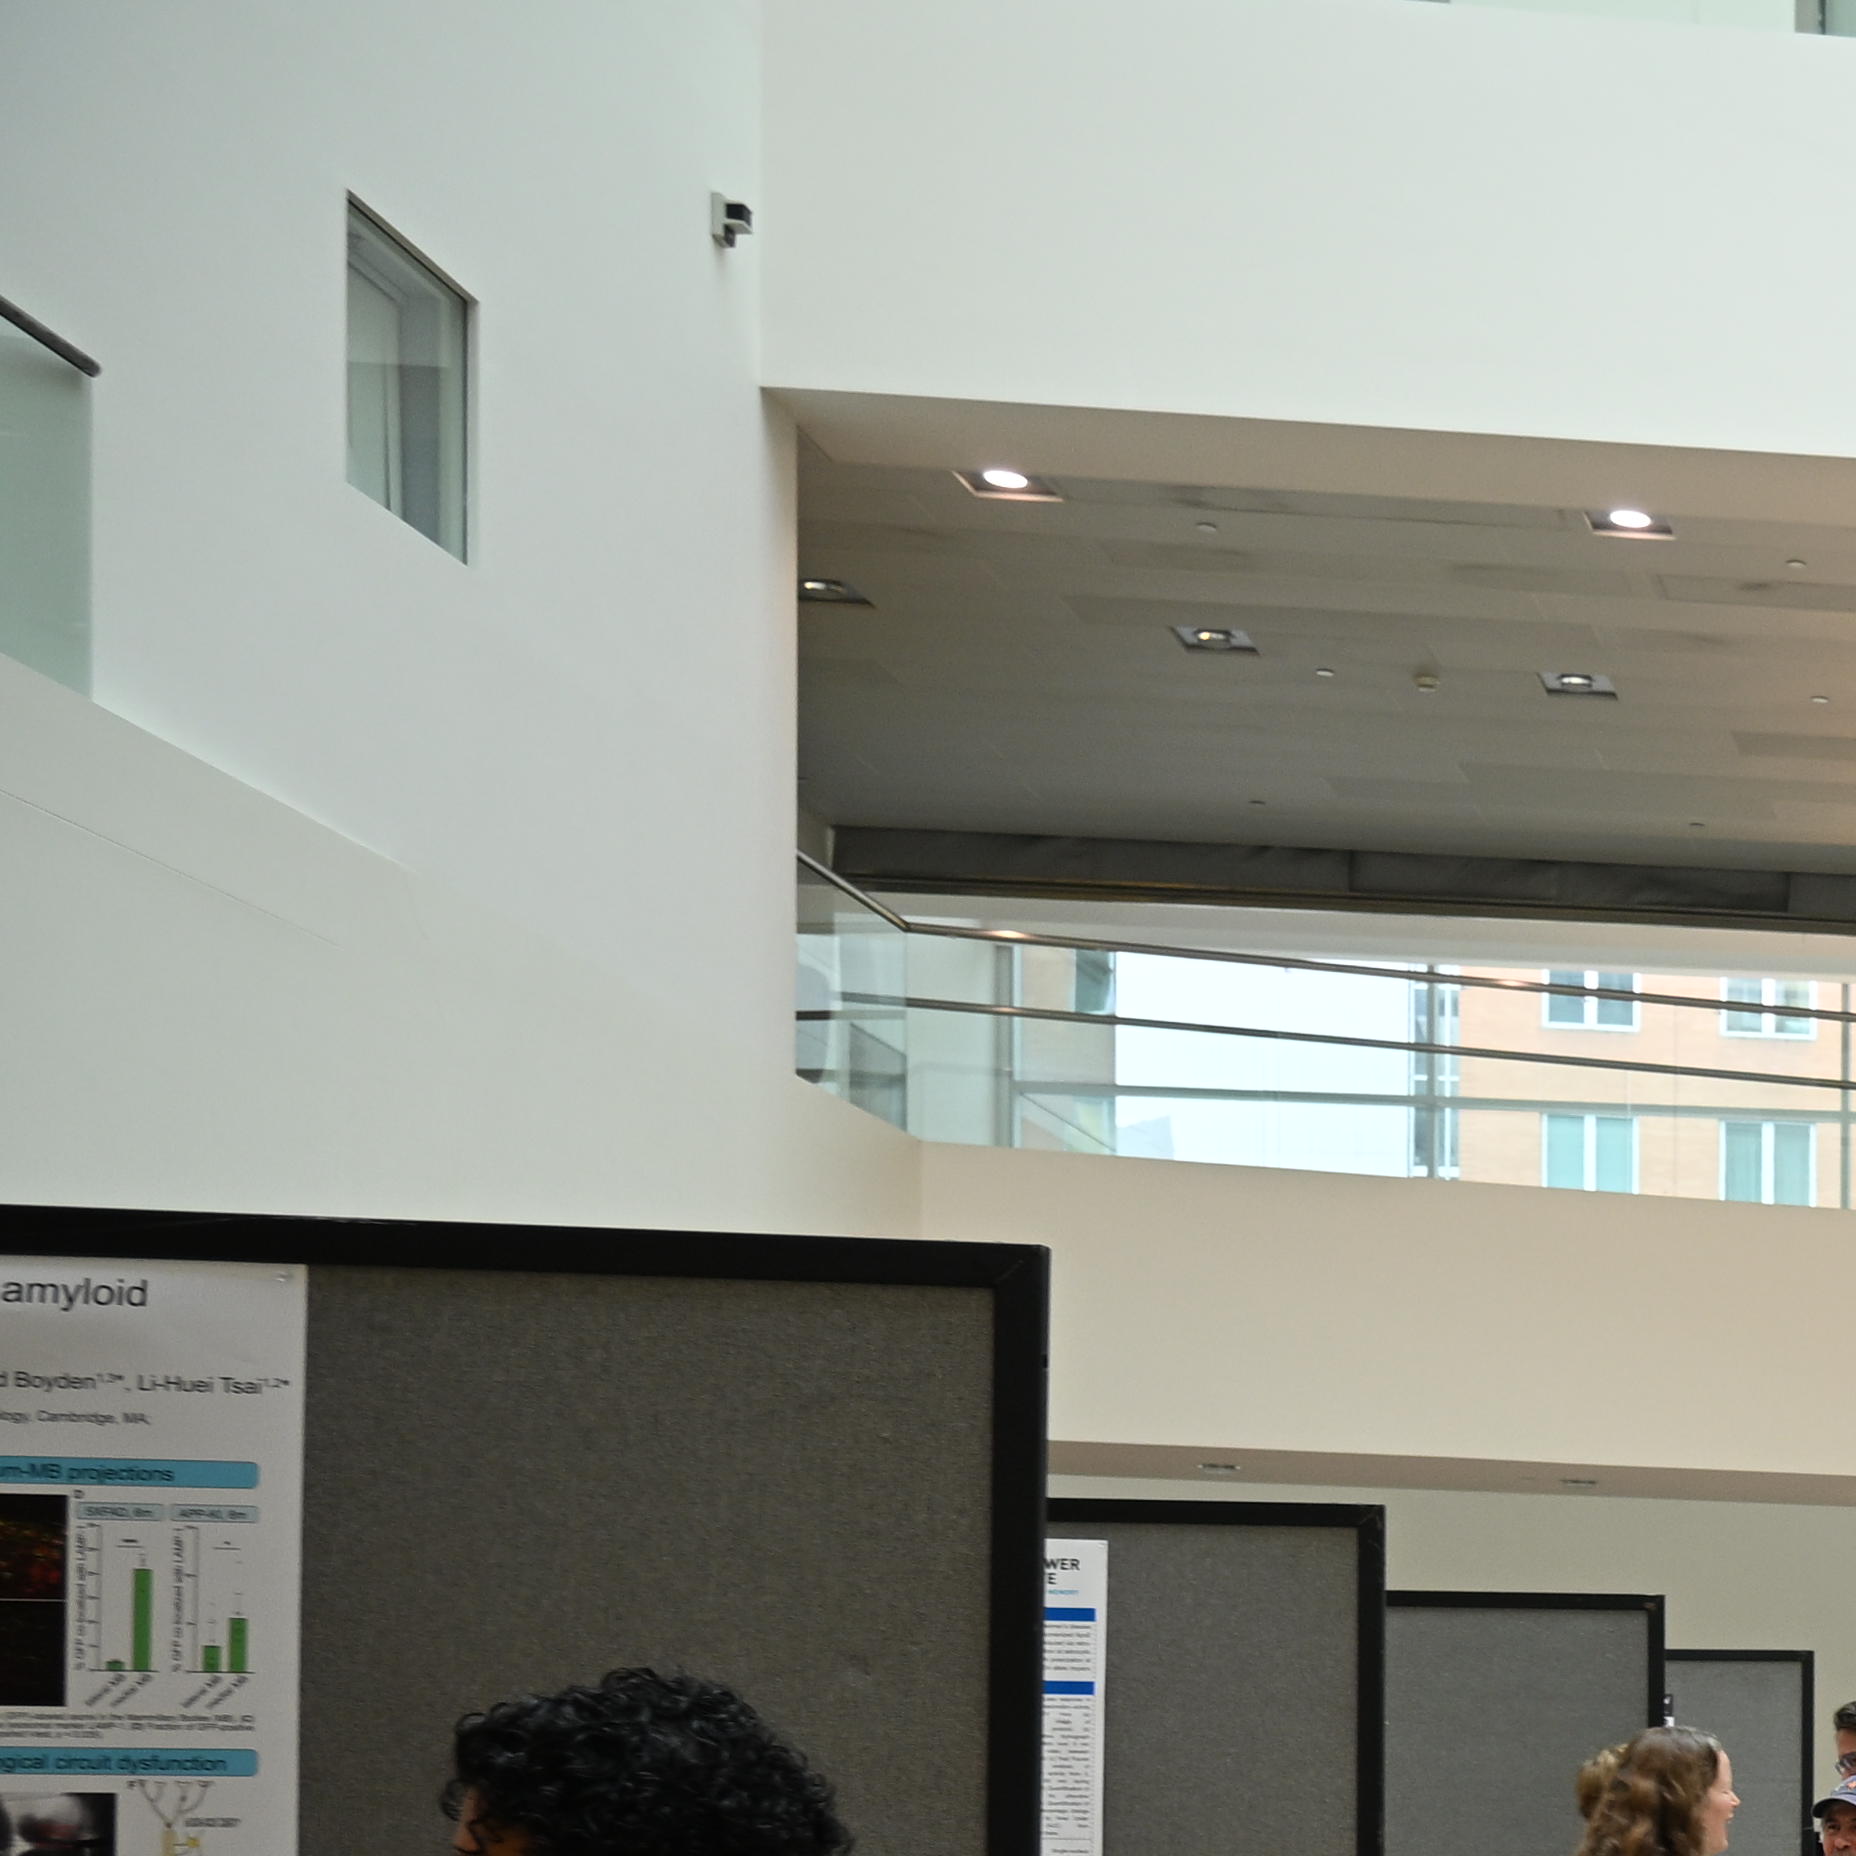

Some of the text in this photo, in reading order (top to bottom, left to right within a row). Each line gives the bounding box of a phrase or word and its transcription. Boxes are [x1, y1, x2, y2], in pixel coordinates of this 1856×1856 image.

[2, 1277, 148, 1312] amyloid
[137, 1374, 214, 1393] Li-Huei
[67, 1465, 174, 1486] projections
[55, 1756, 112, 1770] circuit
[117, 1755, 228, 1774] dysfunction
